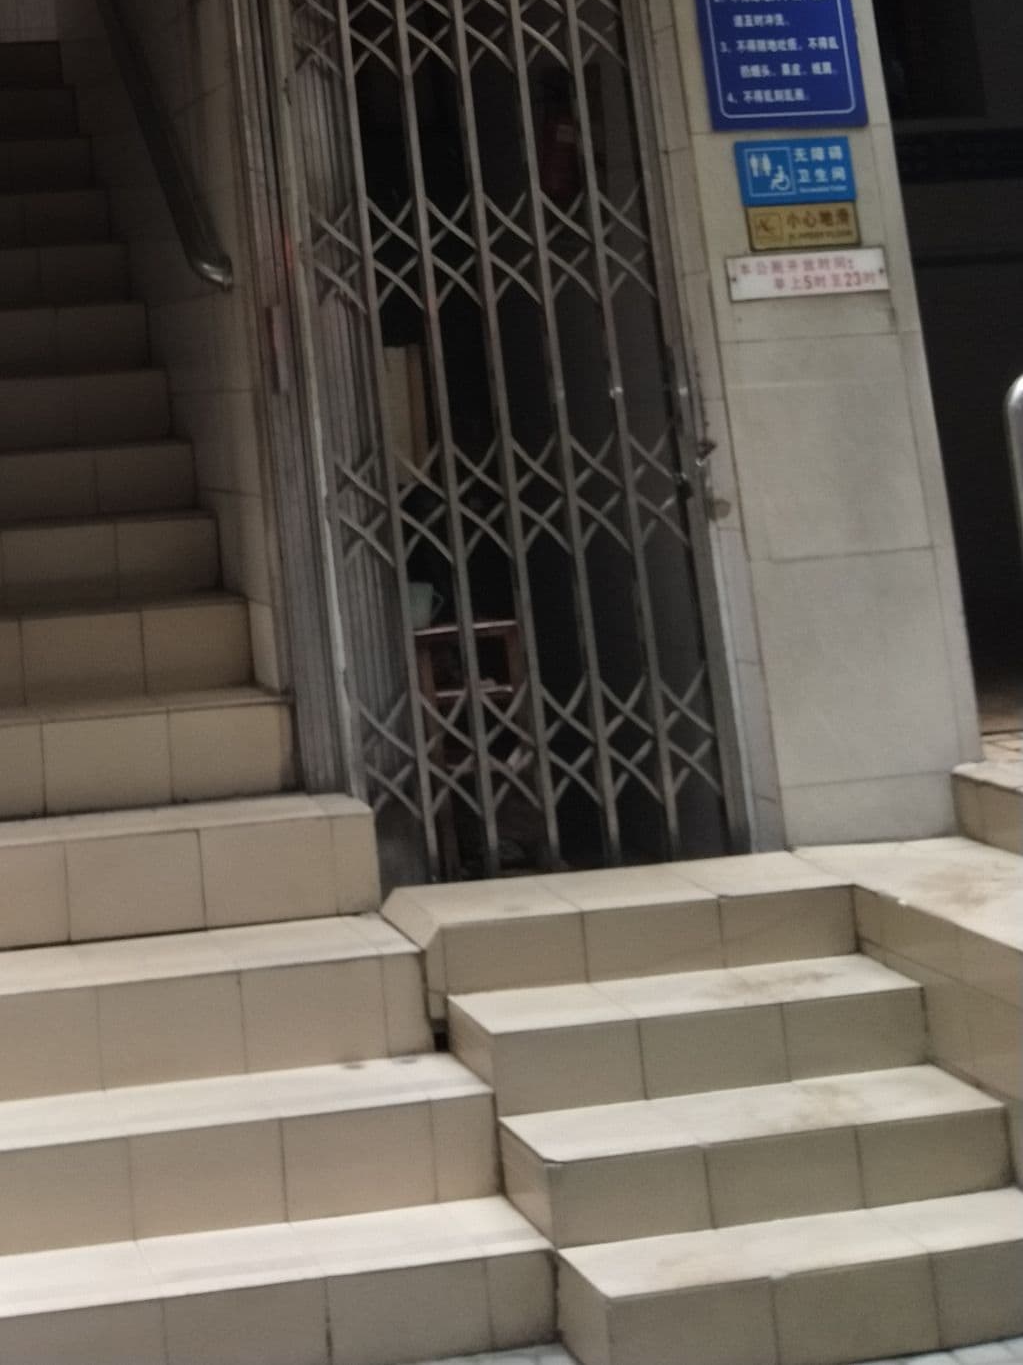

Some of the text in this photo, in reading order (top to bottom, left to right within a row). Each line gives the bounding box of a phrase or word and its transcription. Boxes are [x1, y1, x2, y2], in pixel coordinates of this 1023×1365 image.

[793, 145, 843, 162] 无障碍
[797, 166, 846, 183] 卫生间
[786, 208, 850, 229] 小心地滑
